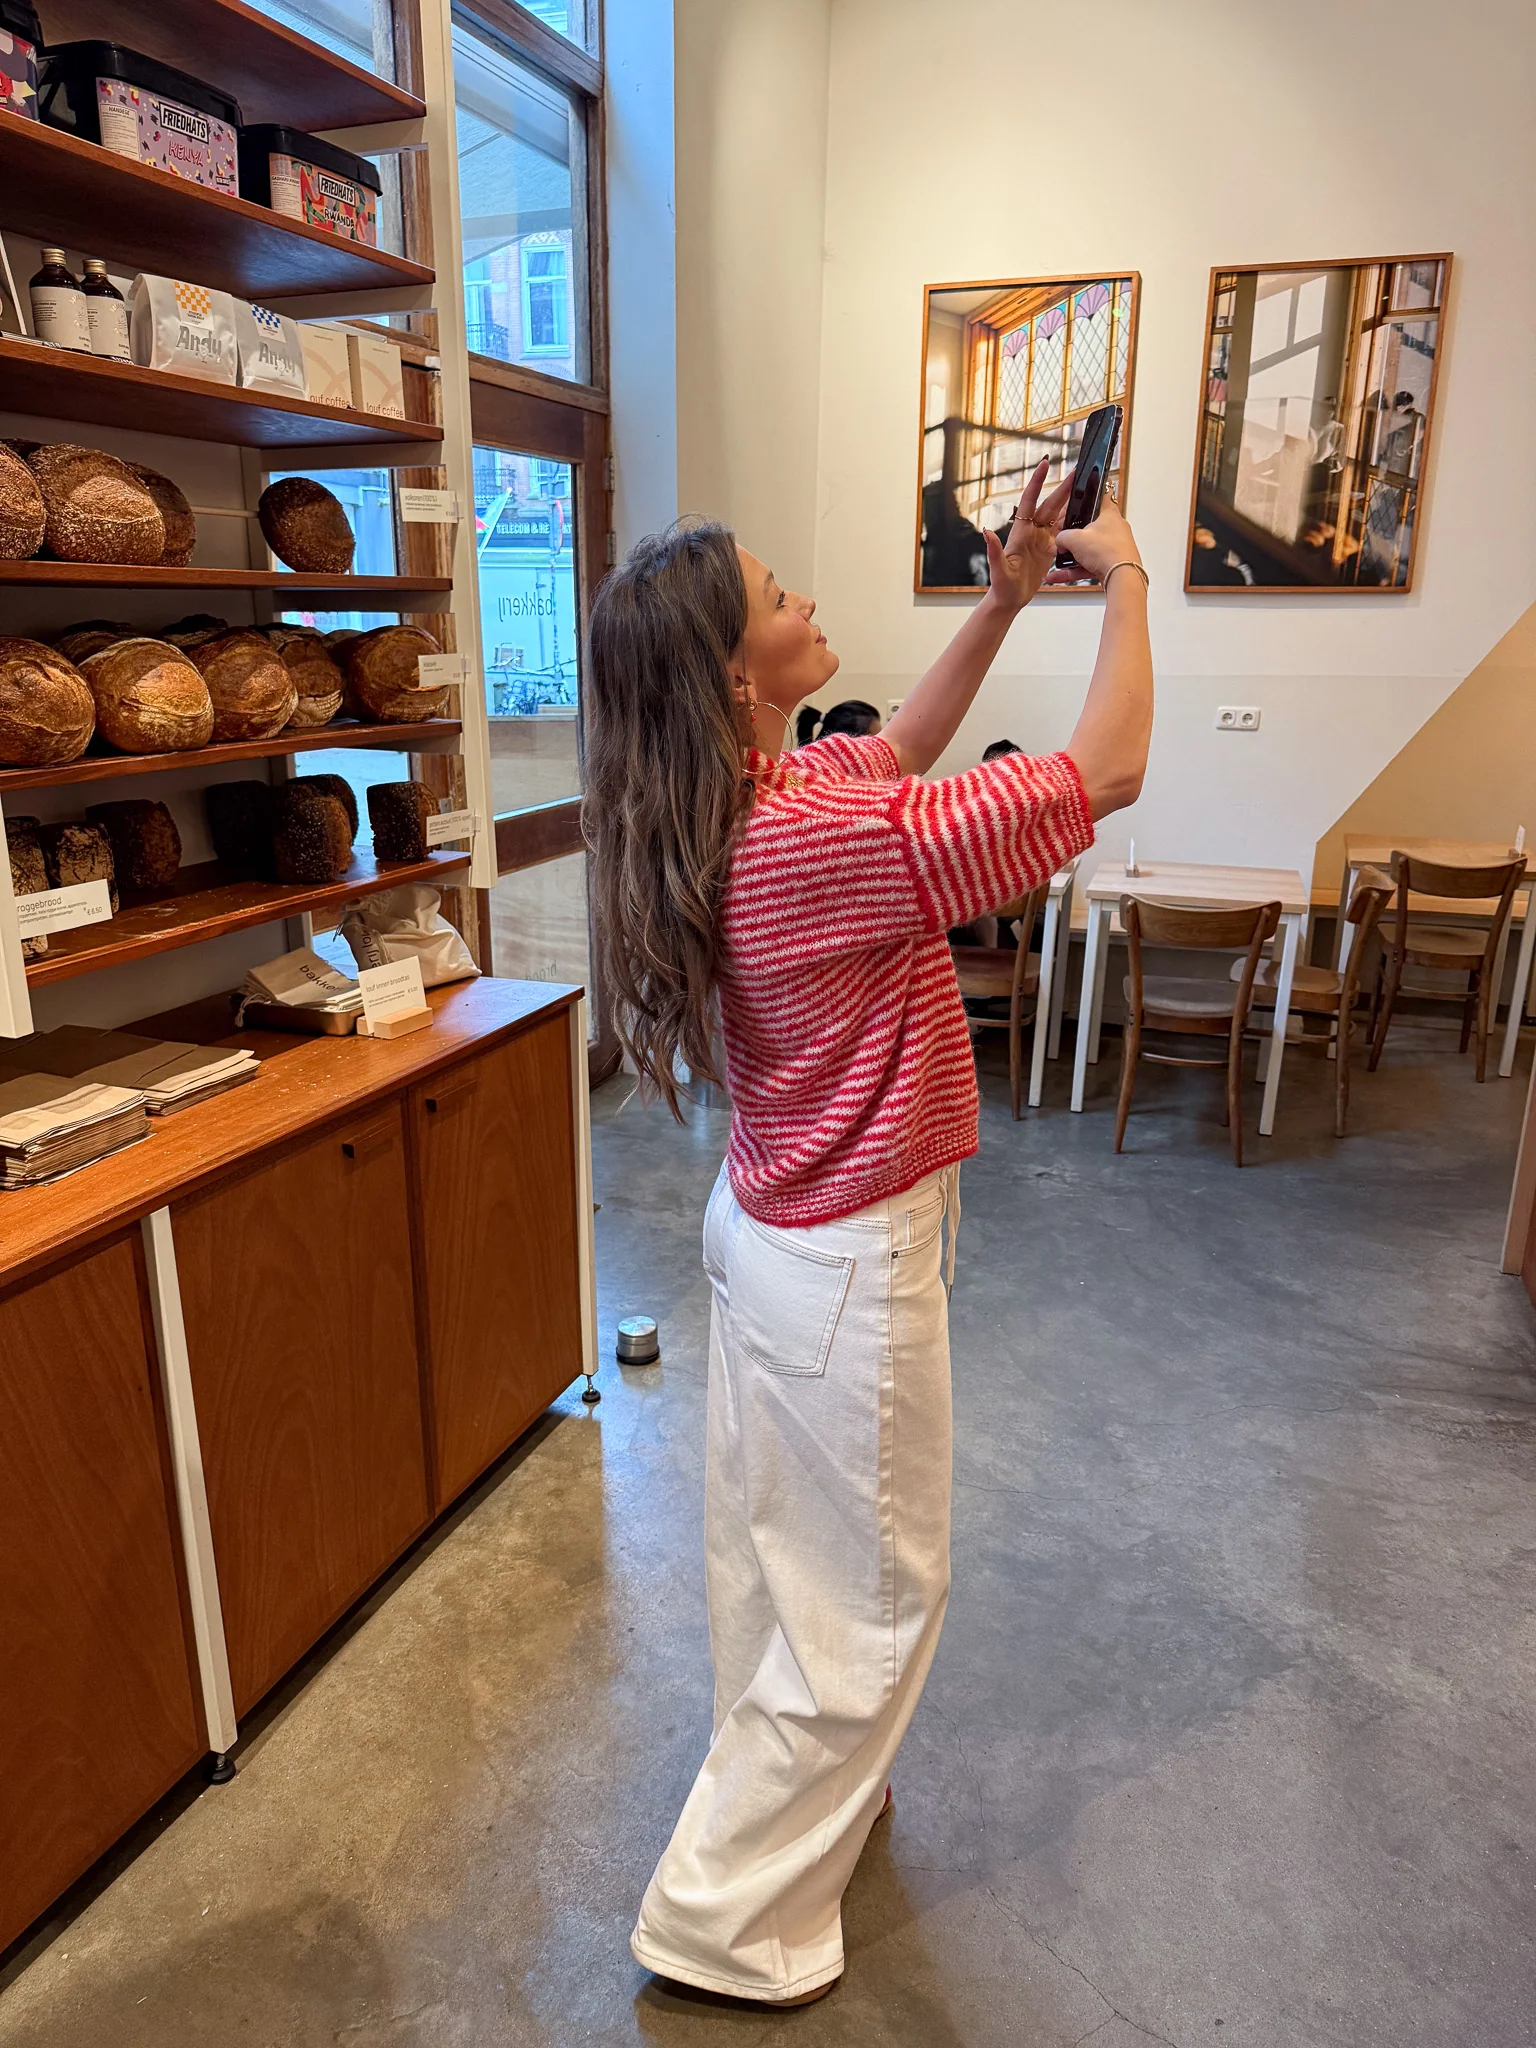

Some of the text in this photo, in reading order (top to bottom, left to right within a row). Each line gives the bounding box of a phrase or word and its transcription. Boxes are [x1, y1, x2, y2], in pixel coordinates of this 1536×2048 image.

[163, 107, 206, 139] FRIEDHATS
[169, 141, 204, 167] KENYA
[320, 177, 354, 203] FRIEDHATS
[324, 208, 355, 230] RWANDA
[176, 325, 222, 358] Andy
[309, 394, 324, 404] ouf
[366, 402, 404, 419] louf coffee
[496, 522, 530, 534] TELECOM
[531, 522, 539, 534] &
[17, 896, 62, 913] roggebrood
[299, 964, 340, 991] bakker
